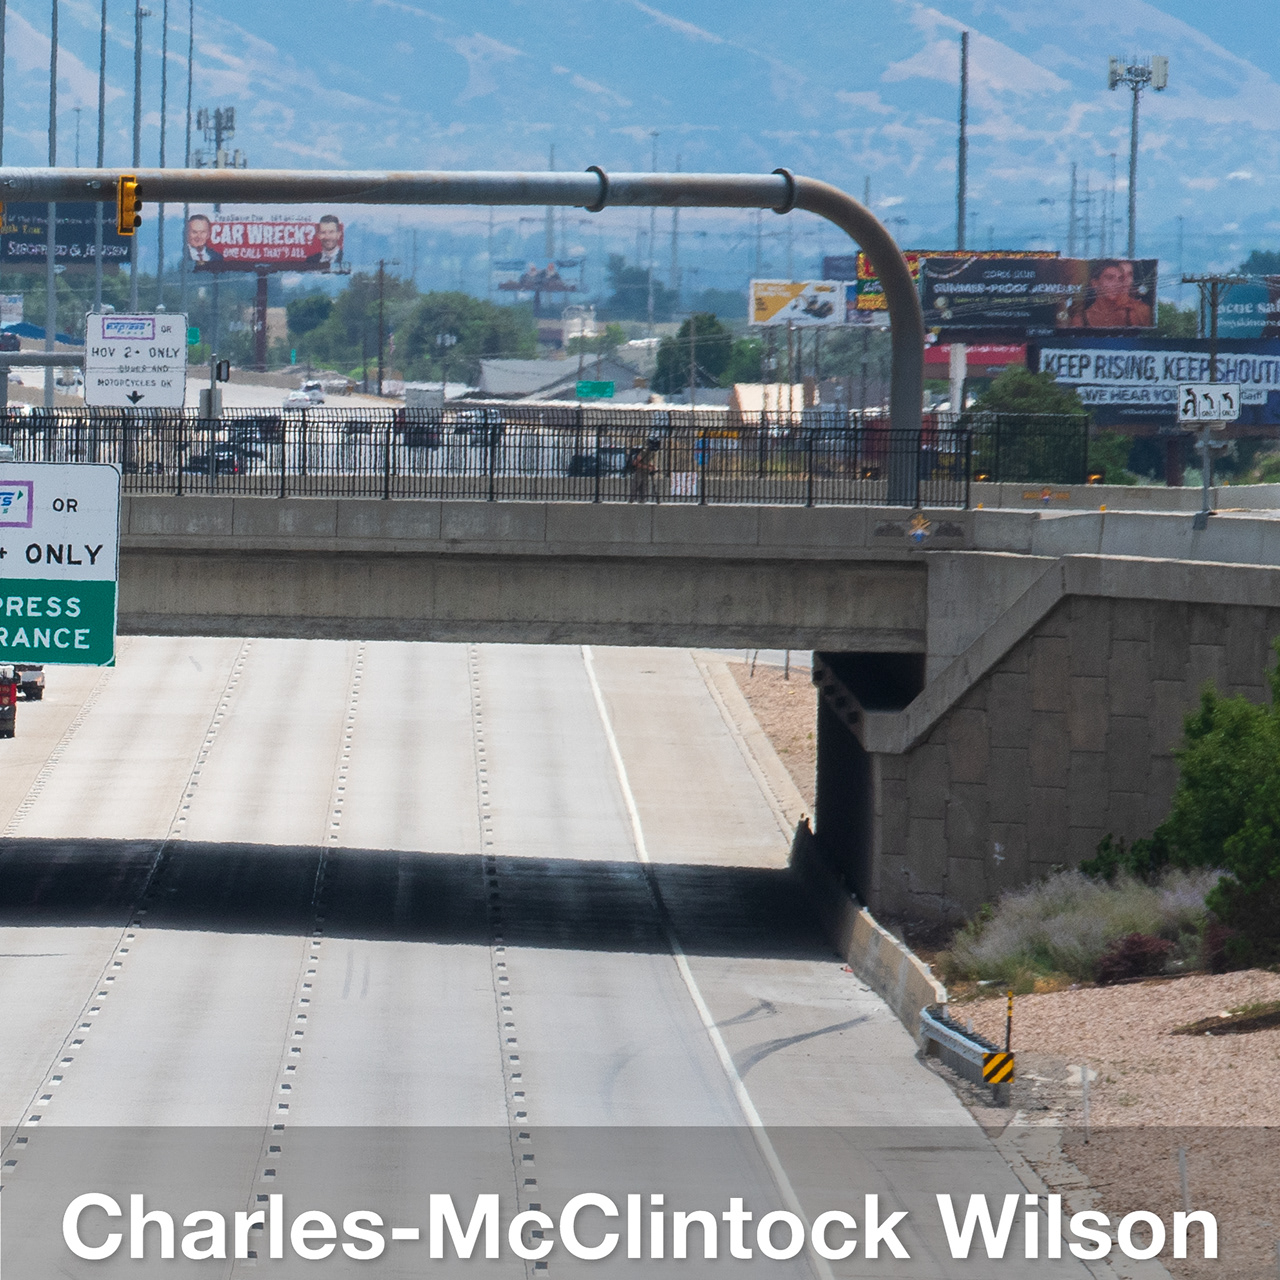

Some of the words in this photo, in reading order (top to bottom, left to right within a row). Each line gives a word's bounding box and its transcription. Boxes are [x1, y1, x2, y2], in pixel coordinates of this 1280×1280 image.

[210, 224, 244, 245] CAR
[247, 224, 316, 245] WRECK?
[161, 325, 171, 333] OR
[92, 347, 115, 357] HOV
[149, 347, 180, 358] ONLY
[1044, 353, 1089, 378] KEEP
[1094, 354, 1160, 382] RISING,
[1162, 356, 1211, 382] KEEP
[1110, 389, 1150, 401] HEAR
[52, 498, 78, 513] OR
[25, 543, 103, 565] ONLY
